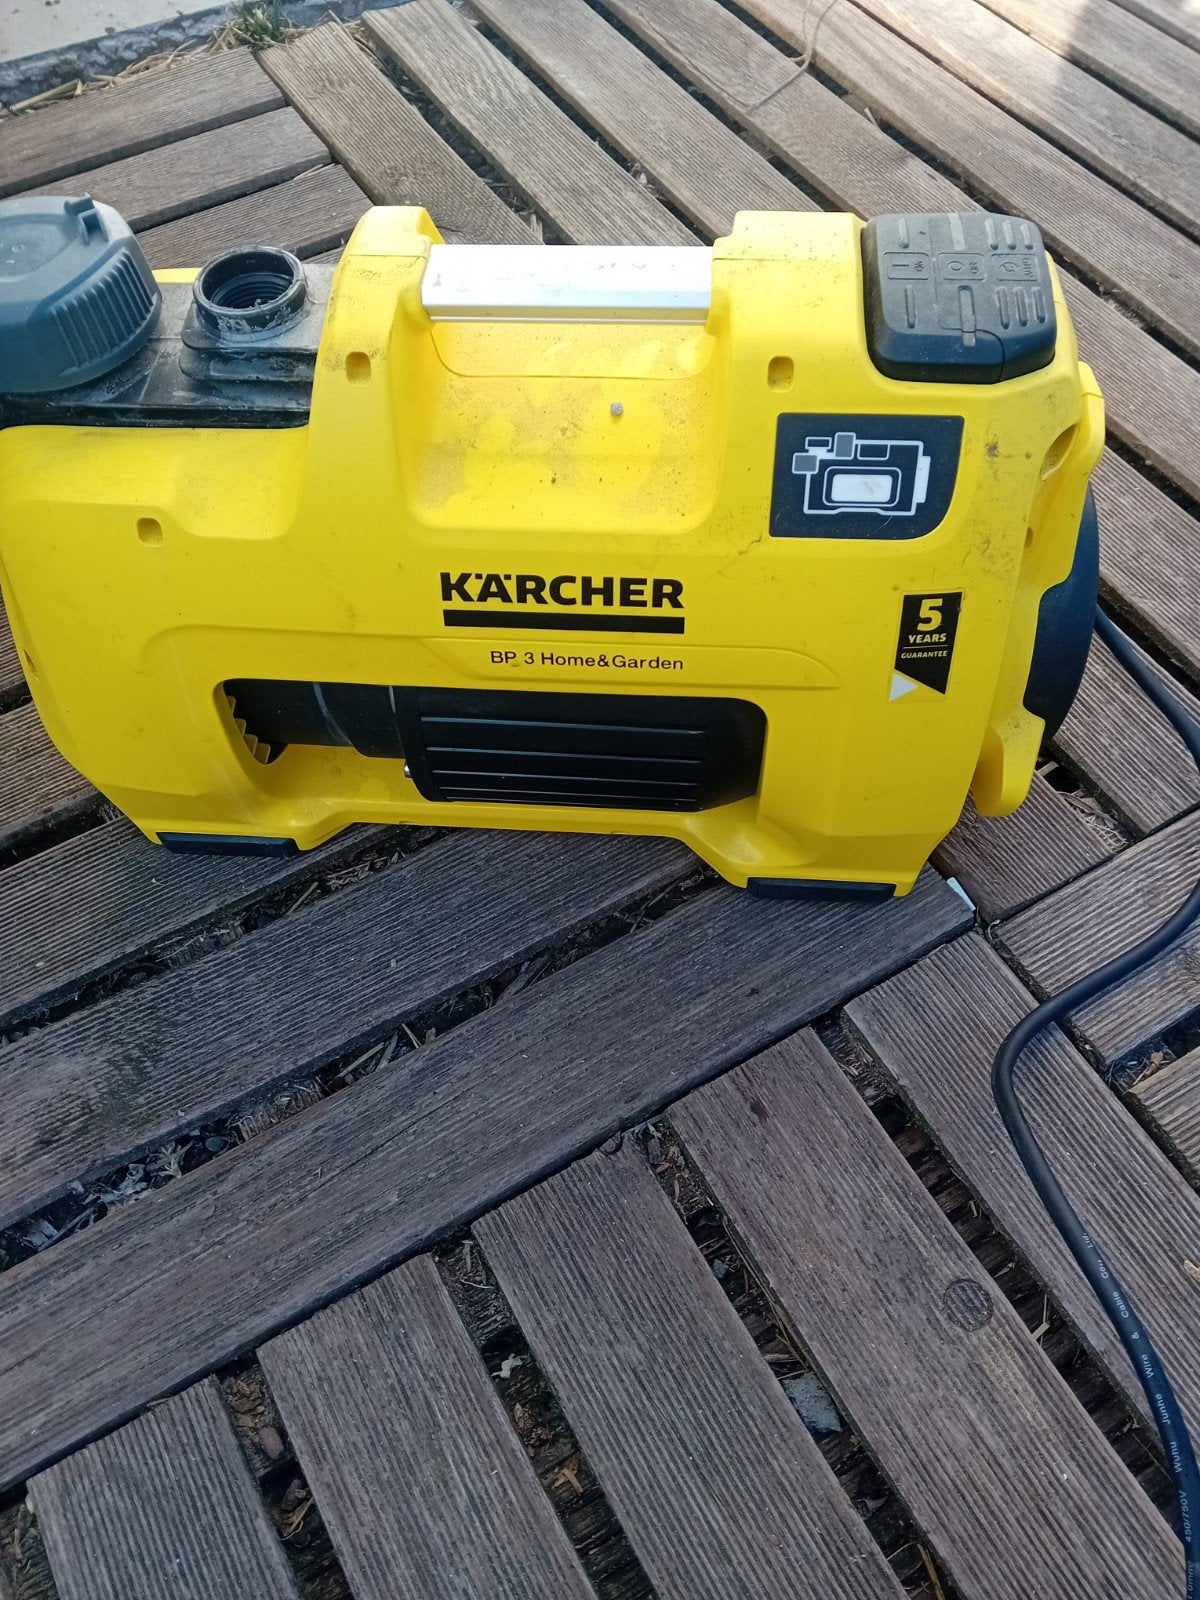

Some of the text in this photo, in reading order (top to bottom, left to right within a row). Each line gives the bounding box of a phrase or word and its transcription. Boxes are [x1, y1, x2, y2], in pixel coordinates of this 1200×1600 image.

[440, 572, 685, 609] KÄRCHER
[916, 598, 943, 631] 5
[908, 633, 947, 644] YEARS
[490, 651, 684, 670] BP 3 Home&Garden
[901, 650, 948, 659] GUARANTEE
[1112, 1291, 1129, 1319] Cable
[1131, 1332, 1140, 1340] &
[1141, 1354, 1155, 1379] Wire
